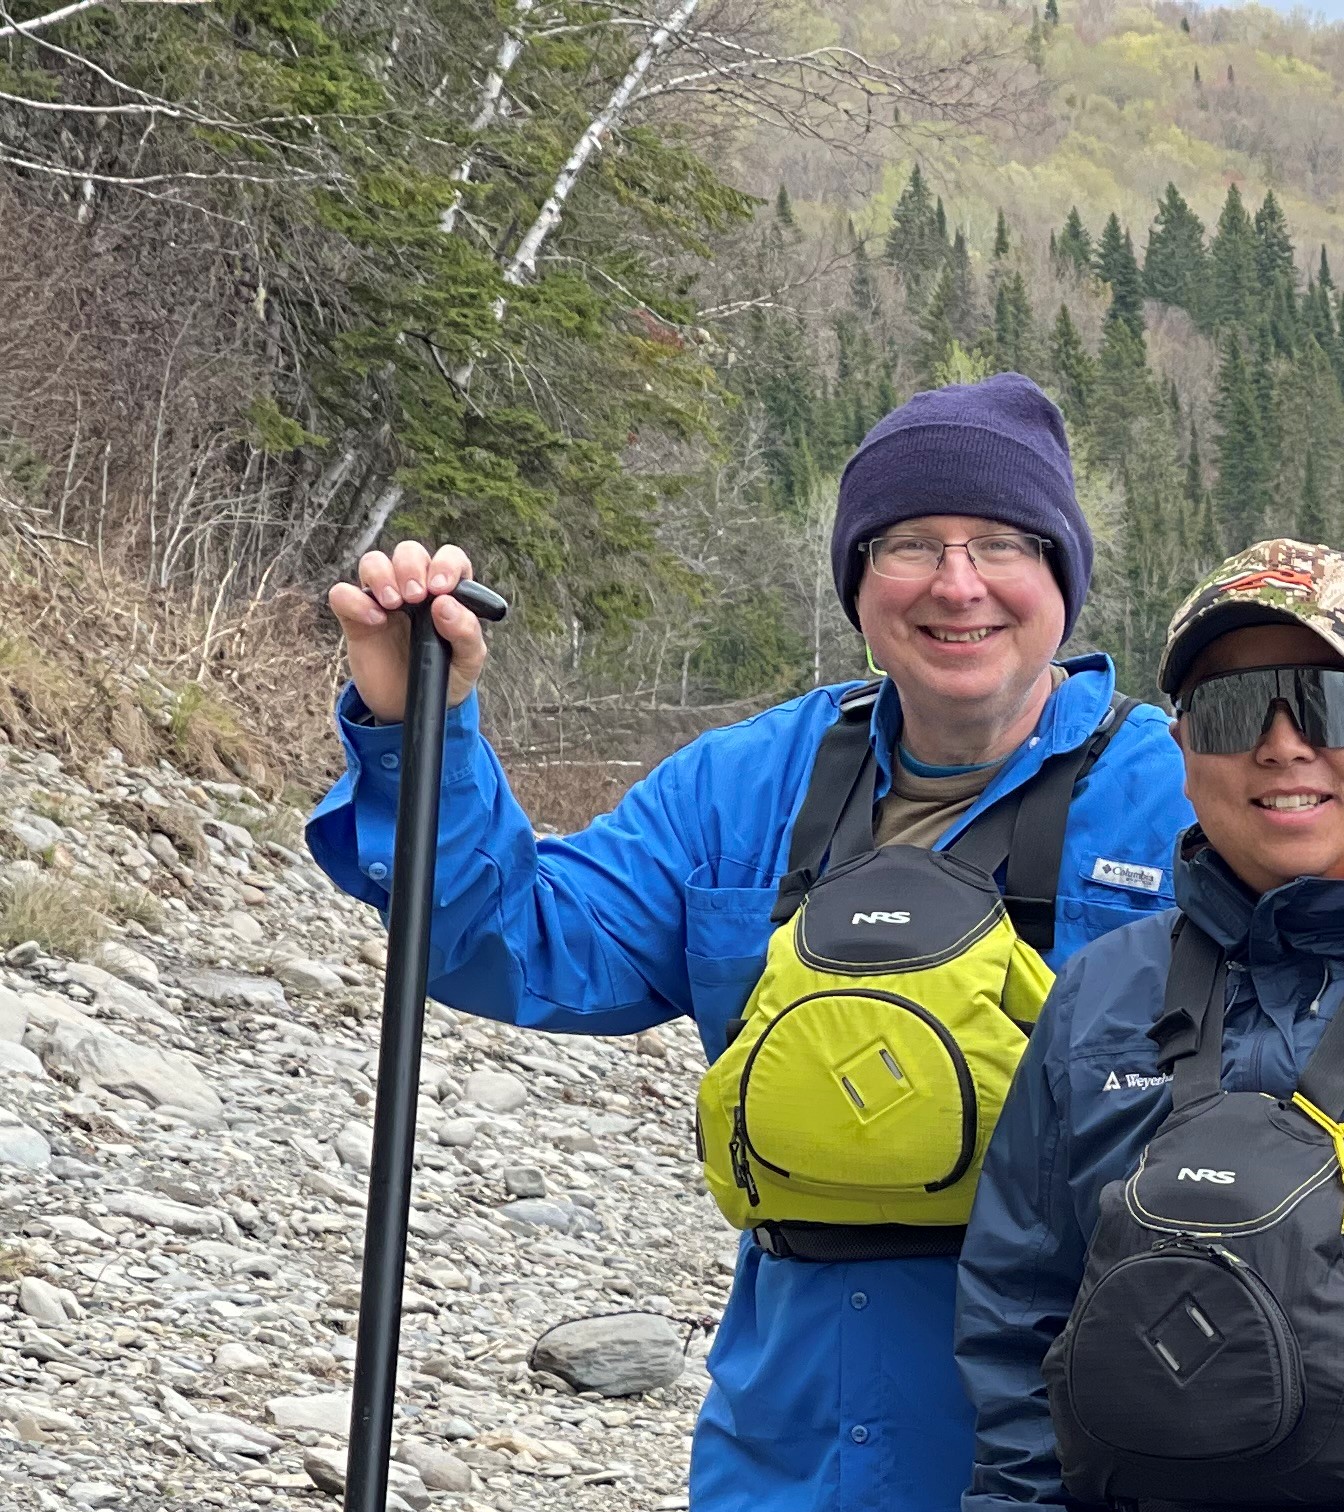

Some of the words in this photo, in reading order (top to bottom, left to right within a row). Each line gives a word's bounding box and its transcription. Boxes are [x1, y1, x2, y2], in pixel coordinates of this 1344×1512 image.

[1112, 866, 1154, 882] Columbia
[851, 911, 911, 925] NRS
[1177, 1167, 1236, 1184] NRS
